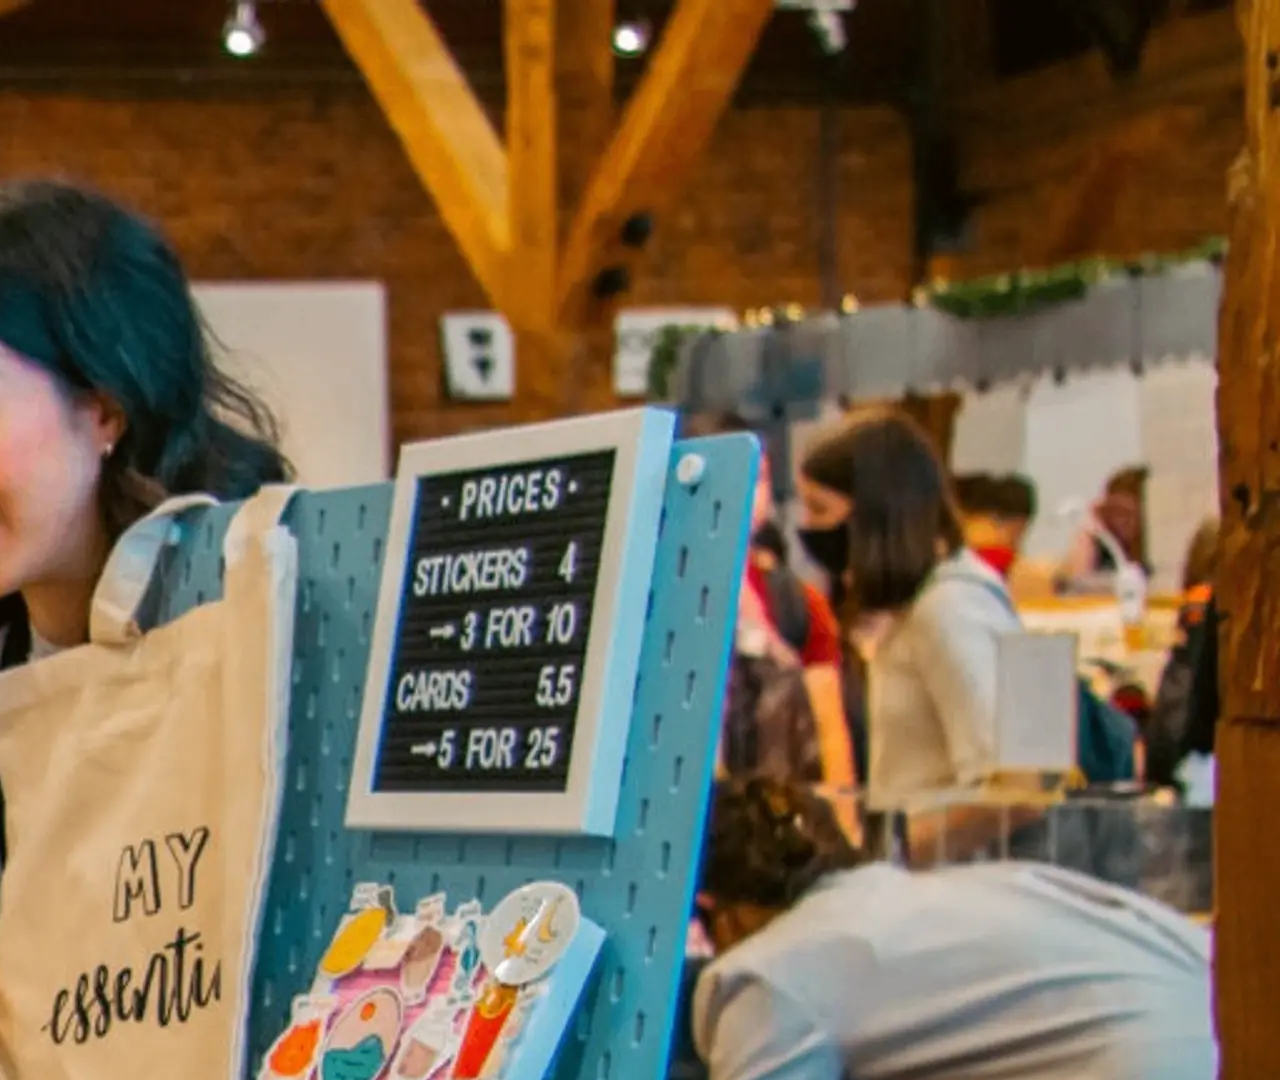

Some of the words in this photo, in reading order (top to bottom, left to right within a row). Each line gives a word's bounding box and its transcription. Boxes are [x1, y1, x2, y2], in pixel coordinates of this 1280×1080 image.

[459, 469, 561, 520] PRICES
[413, 548, 528, 596] STICKERS
[557, 541, 577, 584] 4
[460, 611, 476, 651] 3
[485, 607, 534, 649] FOR
[545, 604, 575, 644] 10
[396, 670, 473, 712] CARDS
[536, 665, 575, 706] 5.5
[437, 730, 455, 770] 5
[465, 728, 516, 769] FOR
[525, 727, 560, 768] 25
[113, 826, 209, 923] MY
